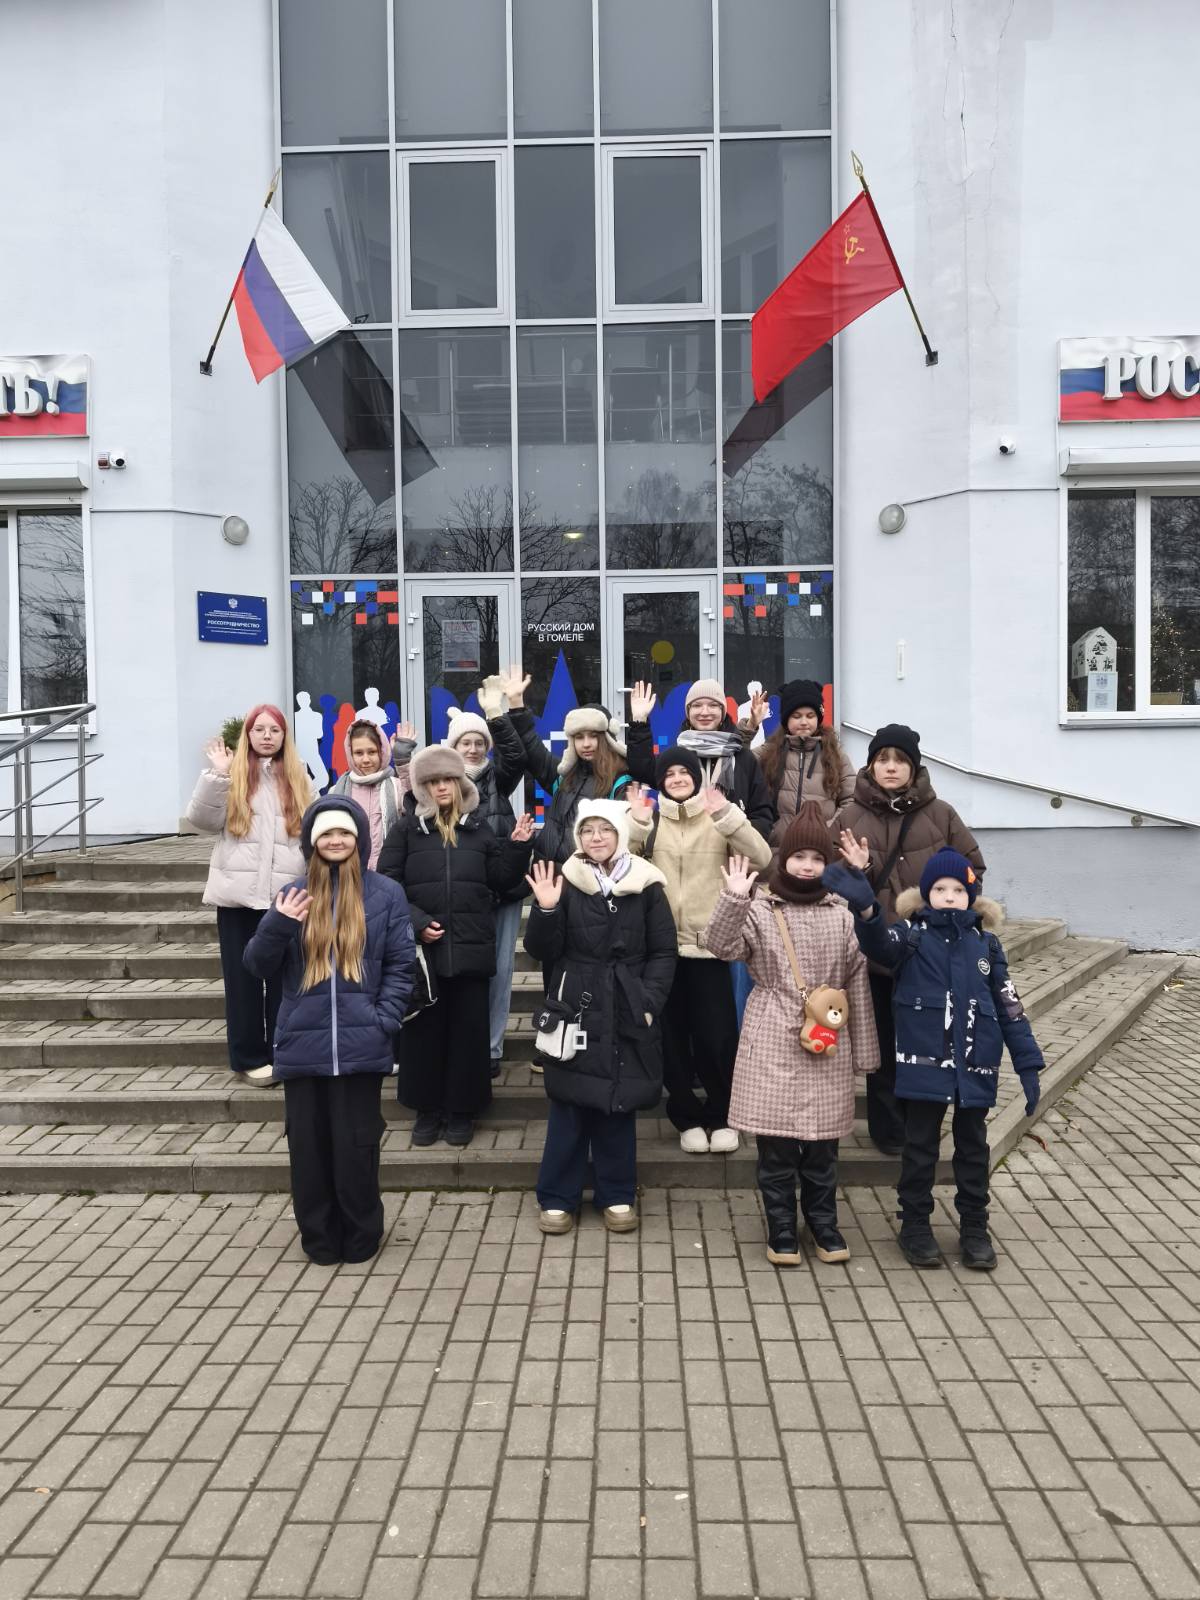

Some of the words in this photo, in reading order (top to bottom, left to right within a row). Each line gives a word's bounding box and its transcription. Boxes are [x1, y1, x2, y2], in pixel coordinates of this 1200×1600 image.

[1102, 353, 1200, 400] РОС
[527, 622, 571, 632] РУССКИЙ
[573, 622, 595, 632] ДОМ
[538, 633, 545, 642] В
[547, 633, 585, 642] ГОМЕЛЕ
